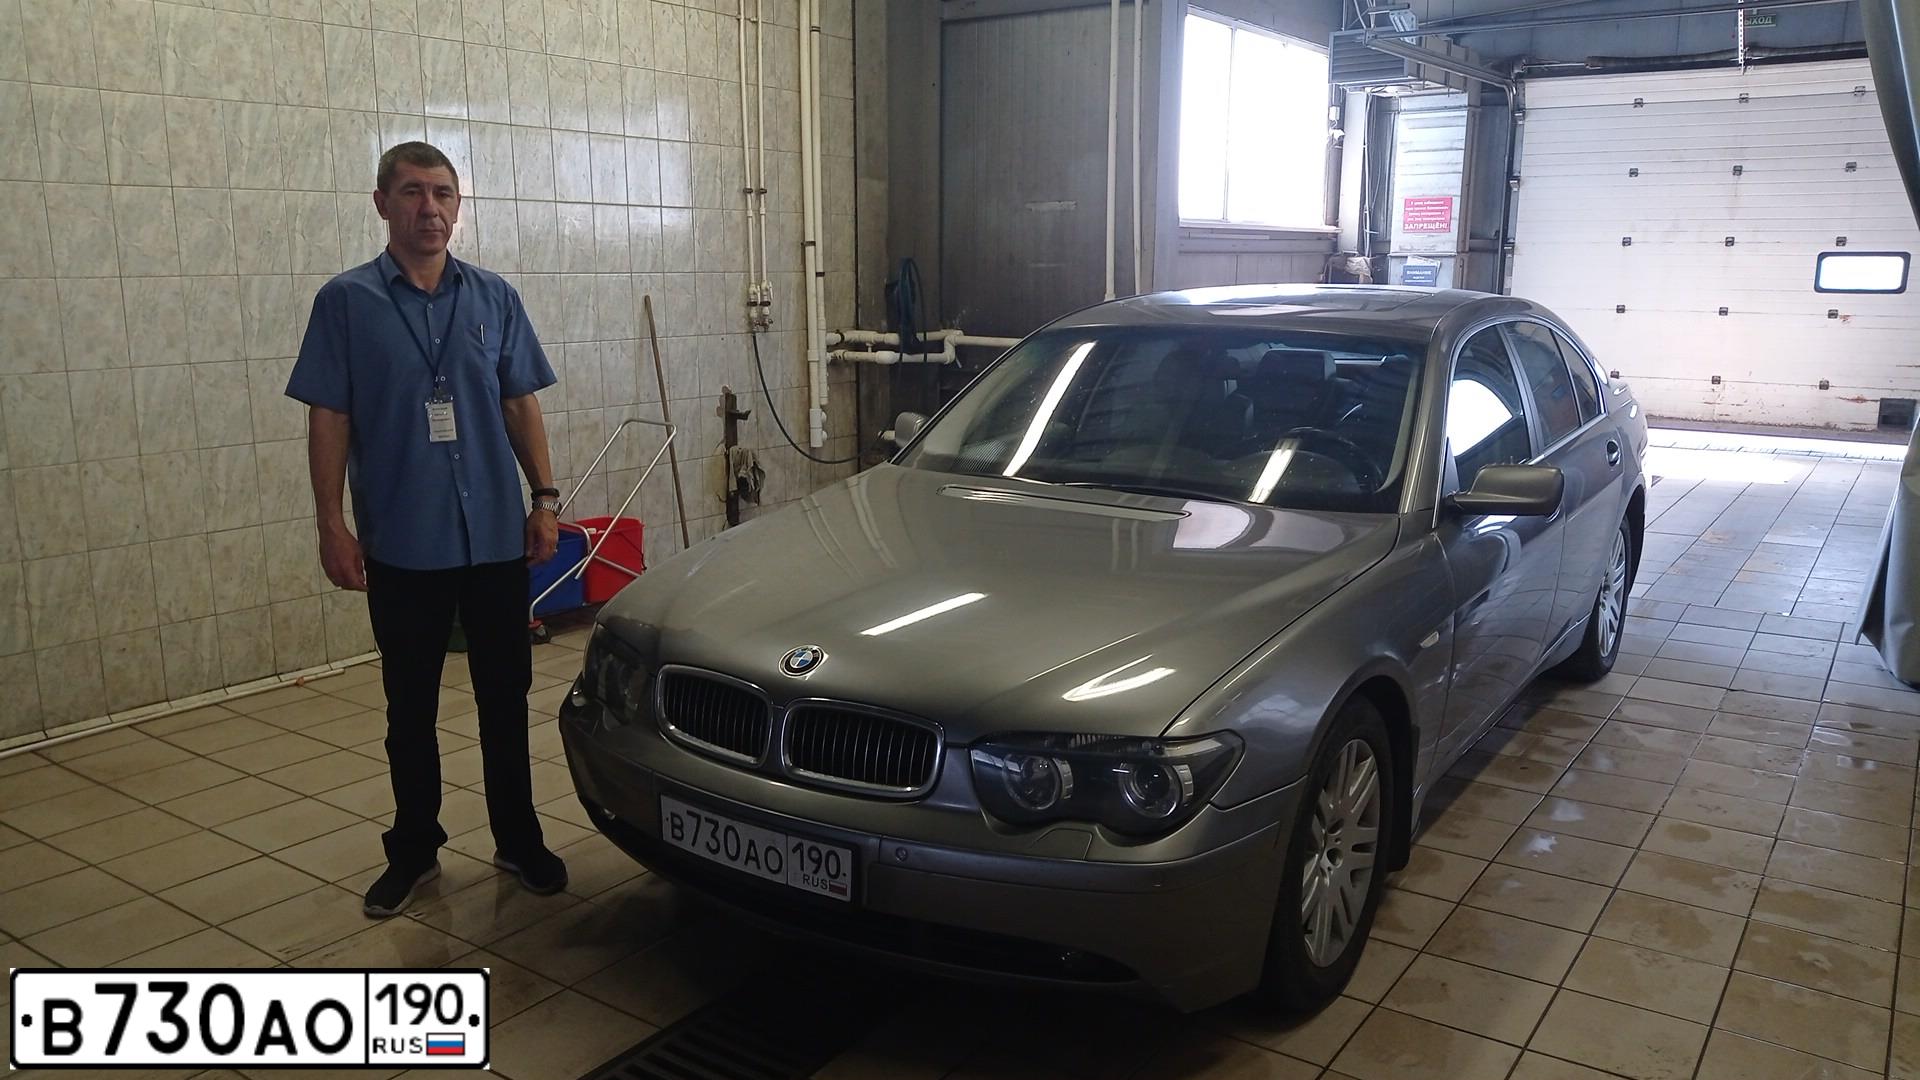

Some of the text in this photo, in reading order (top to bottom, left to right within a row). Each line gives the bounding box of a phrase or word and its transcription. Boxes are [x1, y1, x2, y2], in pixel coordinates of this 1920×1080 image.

[1744, 16, 1773, 26] ЫХОД
[670, 810, 841, 880] В730АО 190
[803, 875, 828, 890] RUS
